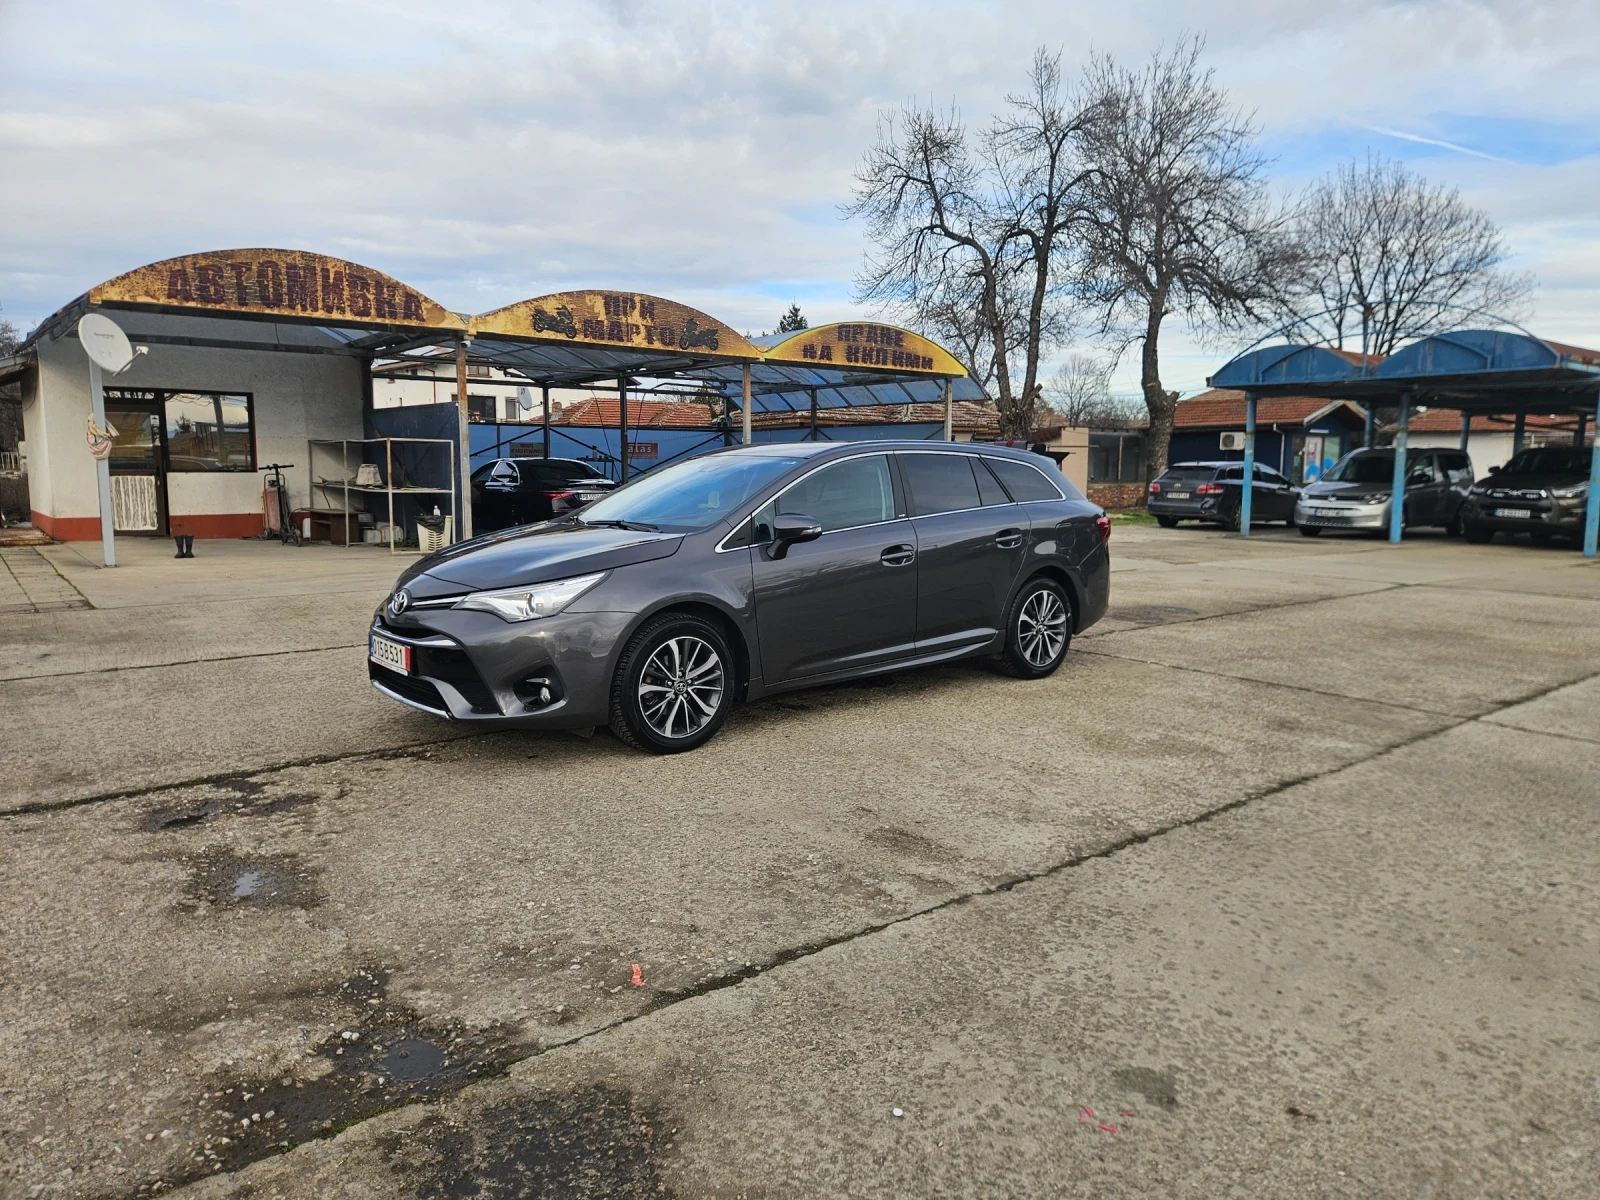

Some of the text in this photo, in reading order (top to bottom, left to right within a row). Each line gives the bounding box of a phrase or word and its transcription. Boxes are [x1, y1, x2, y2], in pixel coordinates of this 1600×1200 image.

[167, 260, 425, 322] АВТОМИВКА
[604, 295, 655, 321] ПРИ
[583, 319, 676, 346] МАРТО
[838, 324, 904, 347] ПРАНЕ
[802, 343, 933, 370] НА КИЛИМИ
